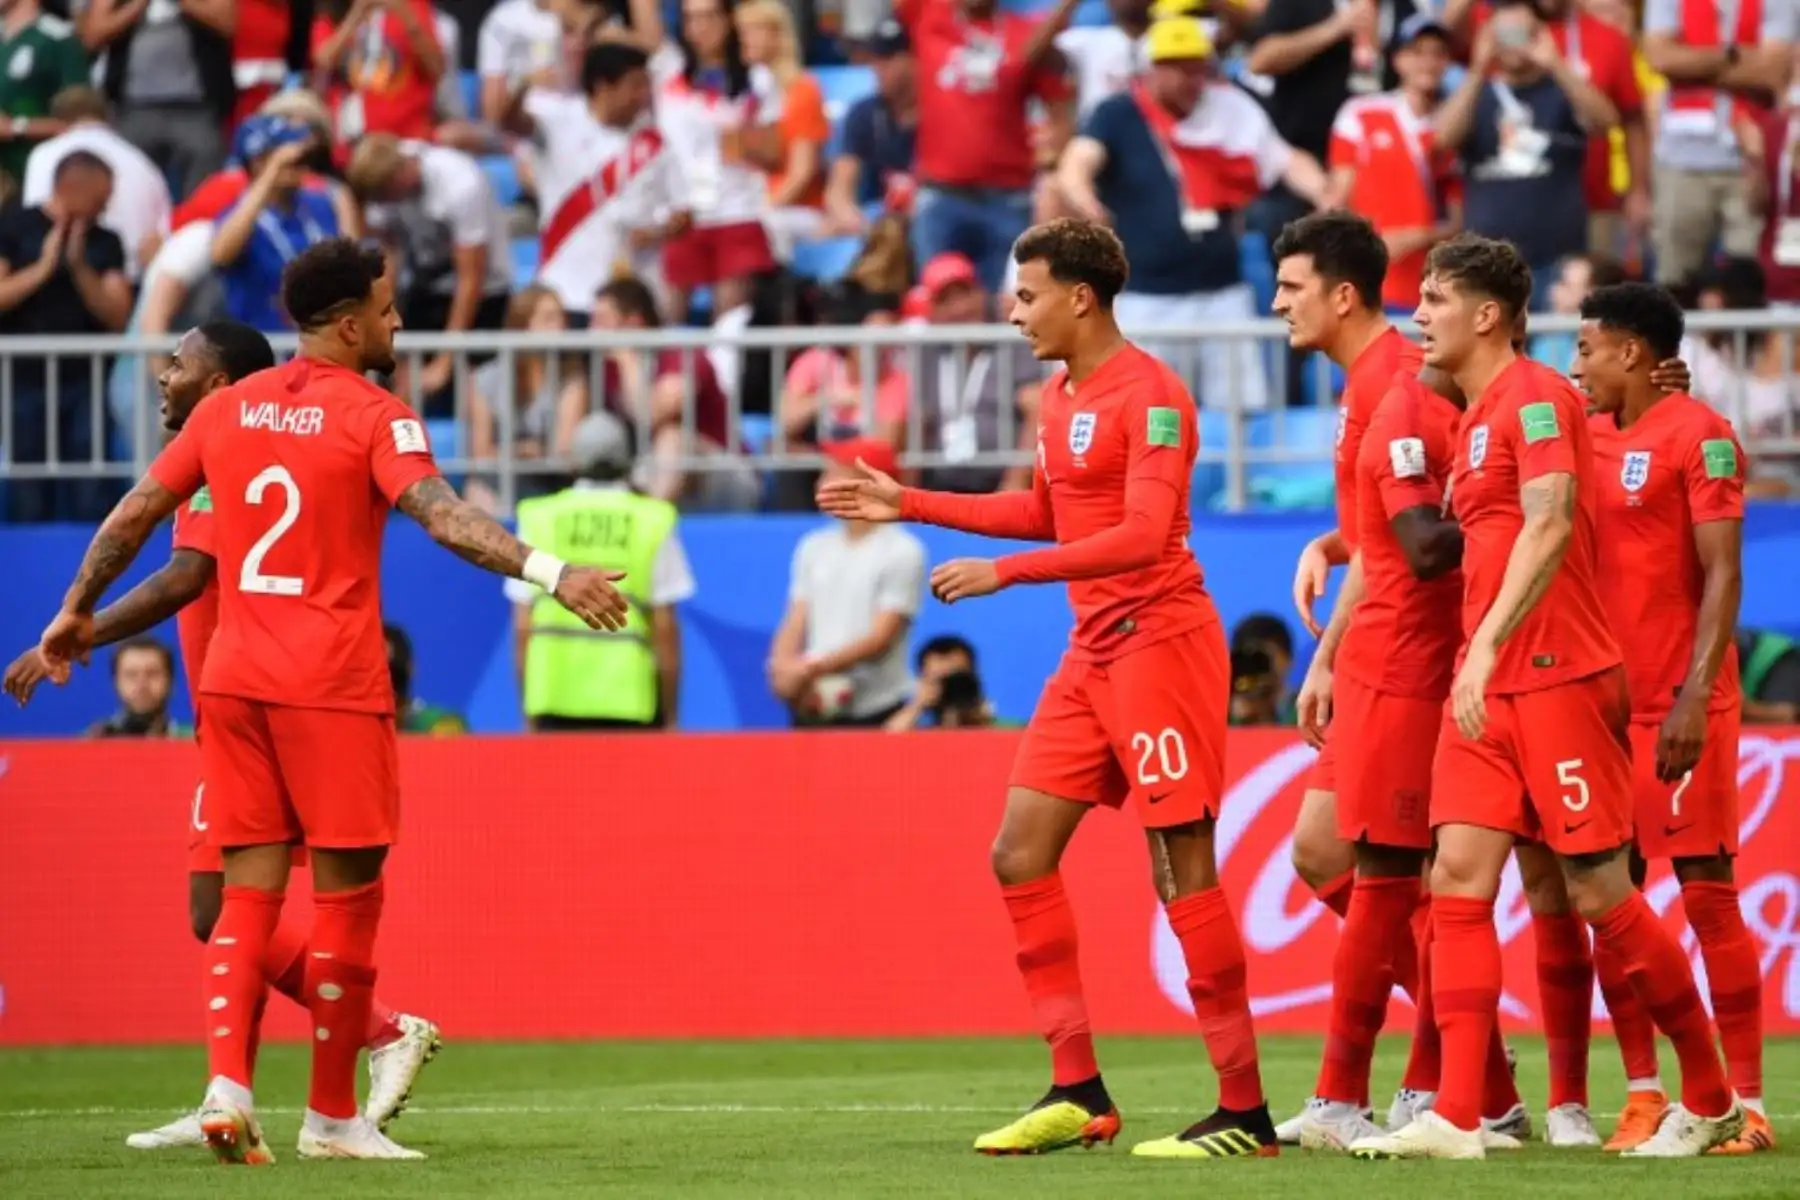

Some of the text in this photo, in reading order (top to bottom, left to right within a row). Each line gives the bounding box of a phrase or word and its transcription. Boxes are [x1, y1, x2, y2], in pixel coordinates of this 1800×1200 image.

[240, 400, 324, 435] WALKER
[239, 464, 303, 596] 2
[1131, 727, 1188, 784] 20
[1556, 758, 1589, 812] 5
